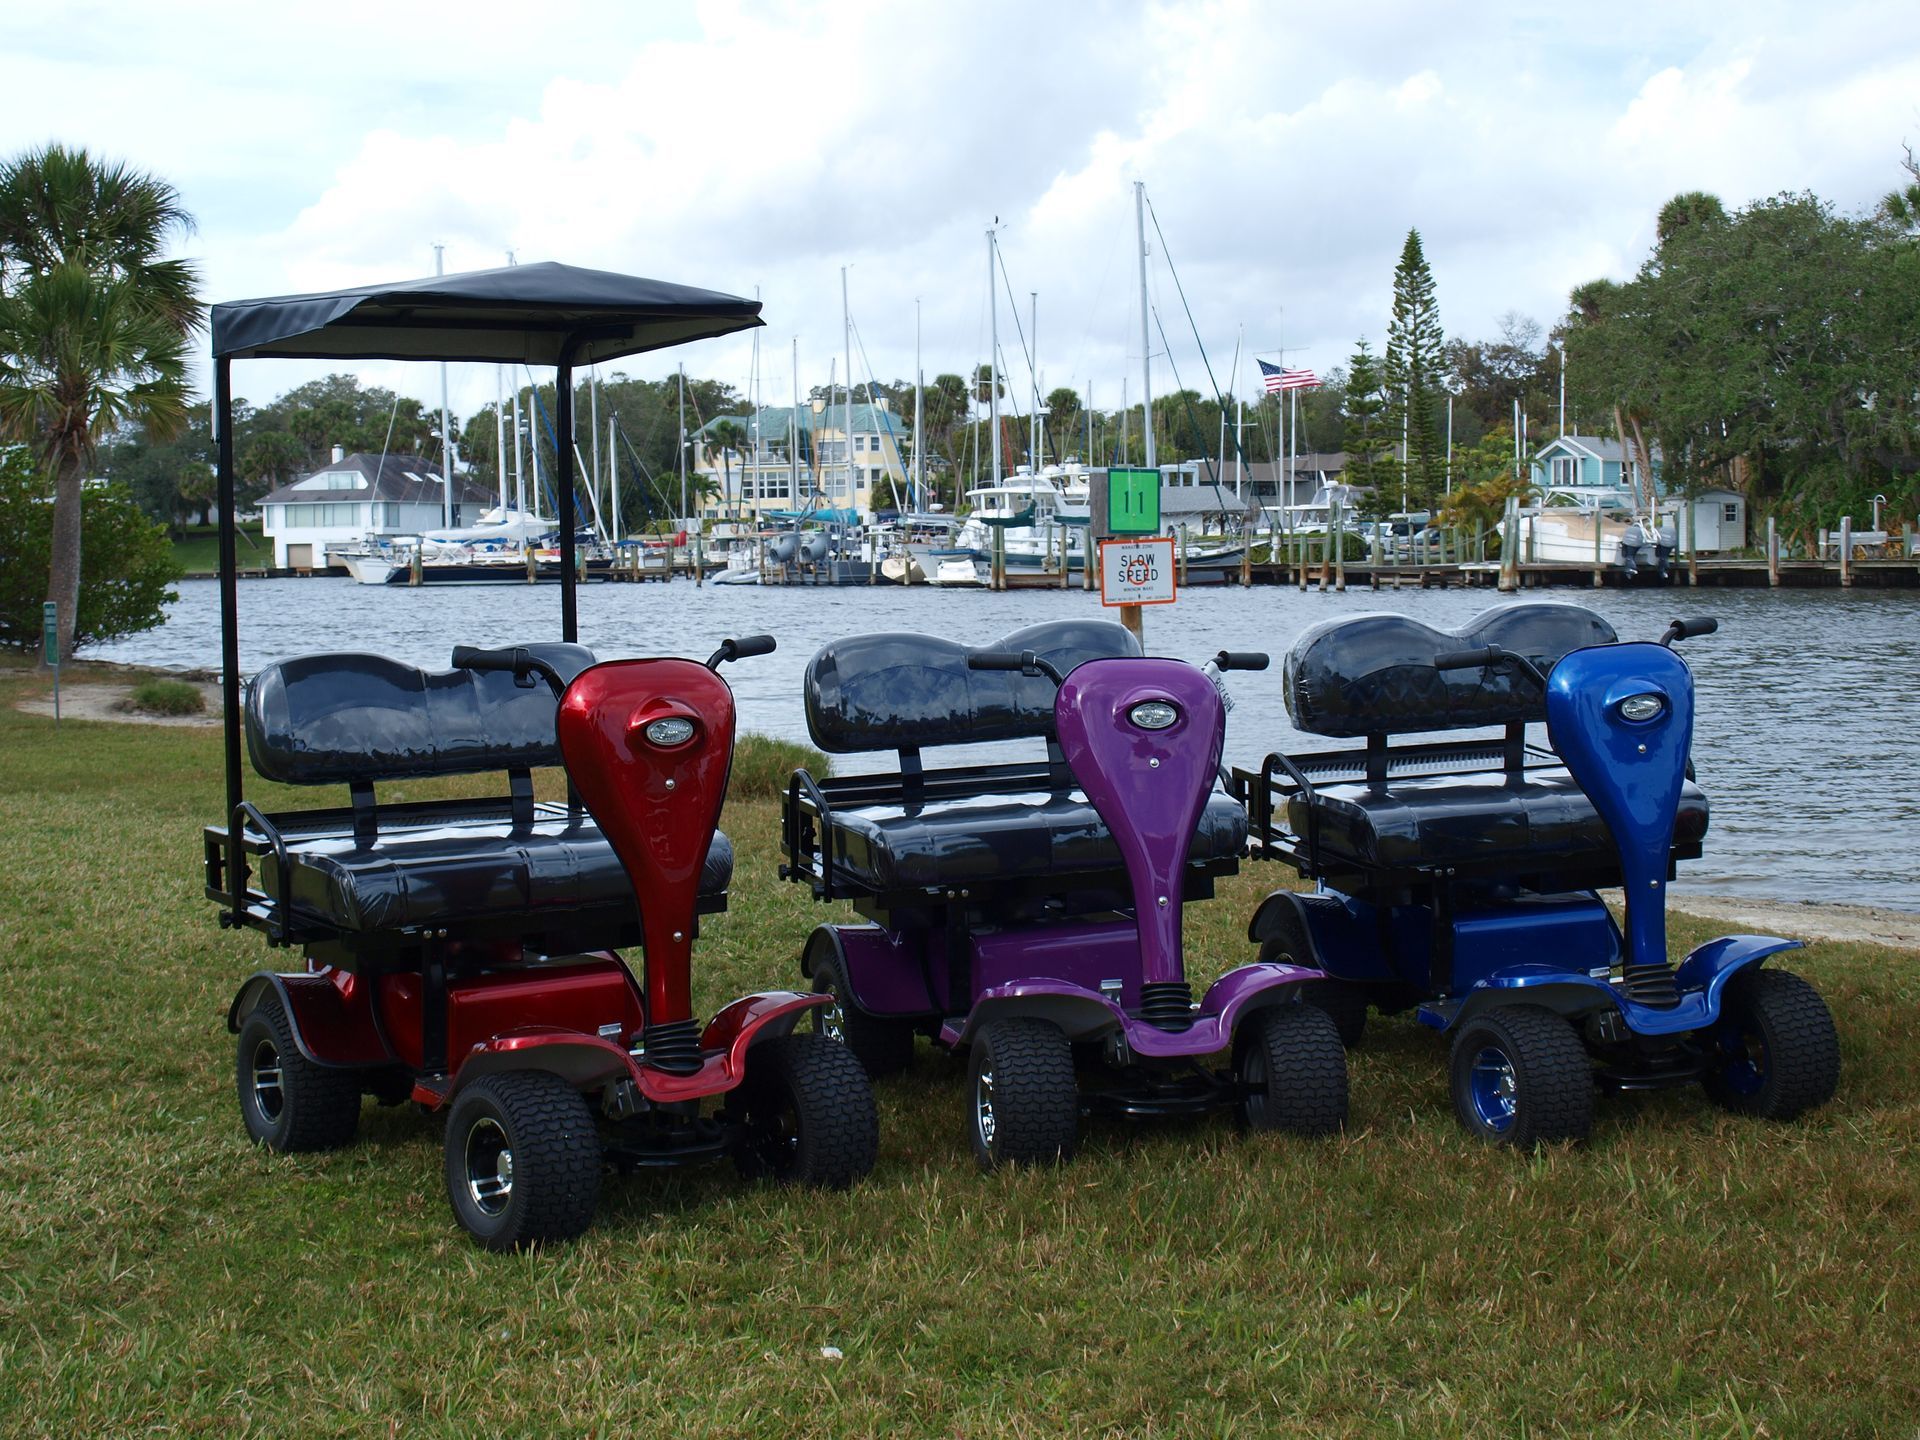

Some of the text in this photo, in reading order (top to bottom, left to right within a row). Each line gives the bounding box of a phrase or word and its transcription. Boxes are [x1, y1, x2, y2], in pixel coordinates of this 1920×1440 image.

[1124, 491, 1144, 514] 11
[1121, 554, 1155, 567] SLOW
[1118, 568, 1159, 582] SPEED
